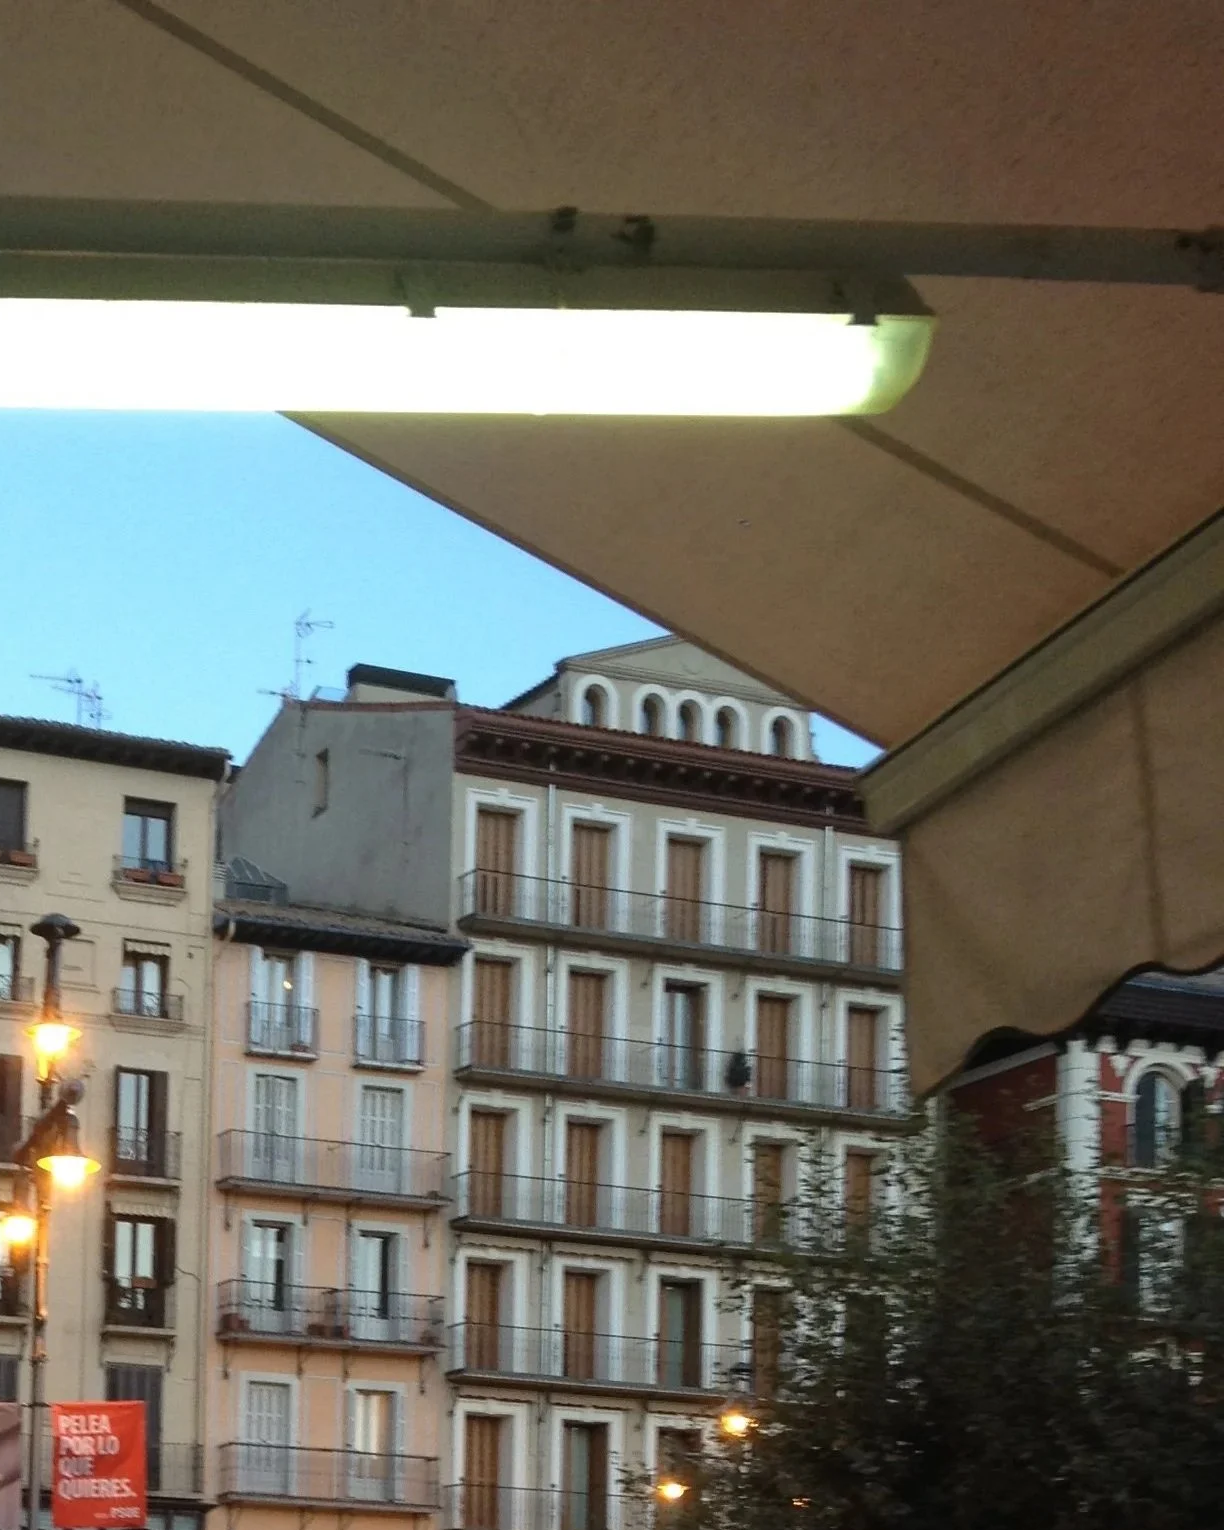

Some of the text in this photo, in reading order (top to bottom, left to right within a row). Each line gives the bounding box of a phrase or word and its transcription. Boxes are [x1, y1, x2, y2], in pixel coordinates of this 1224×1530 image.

[58, 1414, 112, 1434] PELEA
[58, 1435, 120, 1456] POR LO
[58, 1456, 94, 1478] QUE
[109, 1506, 141, 1519] PSOE
